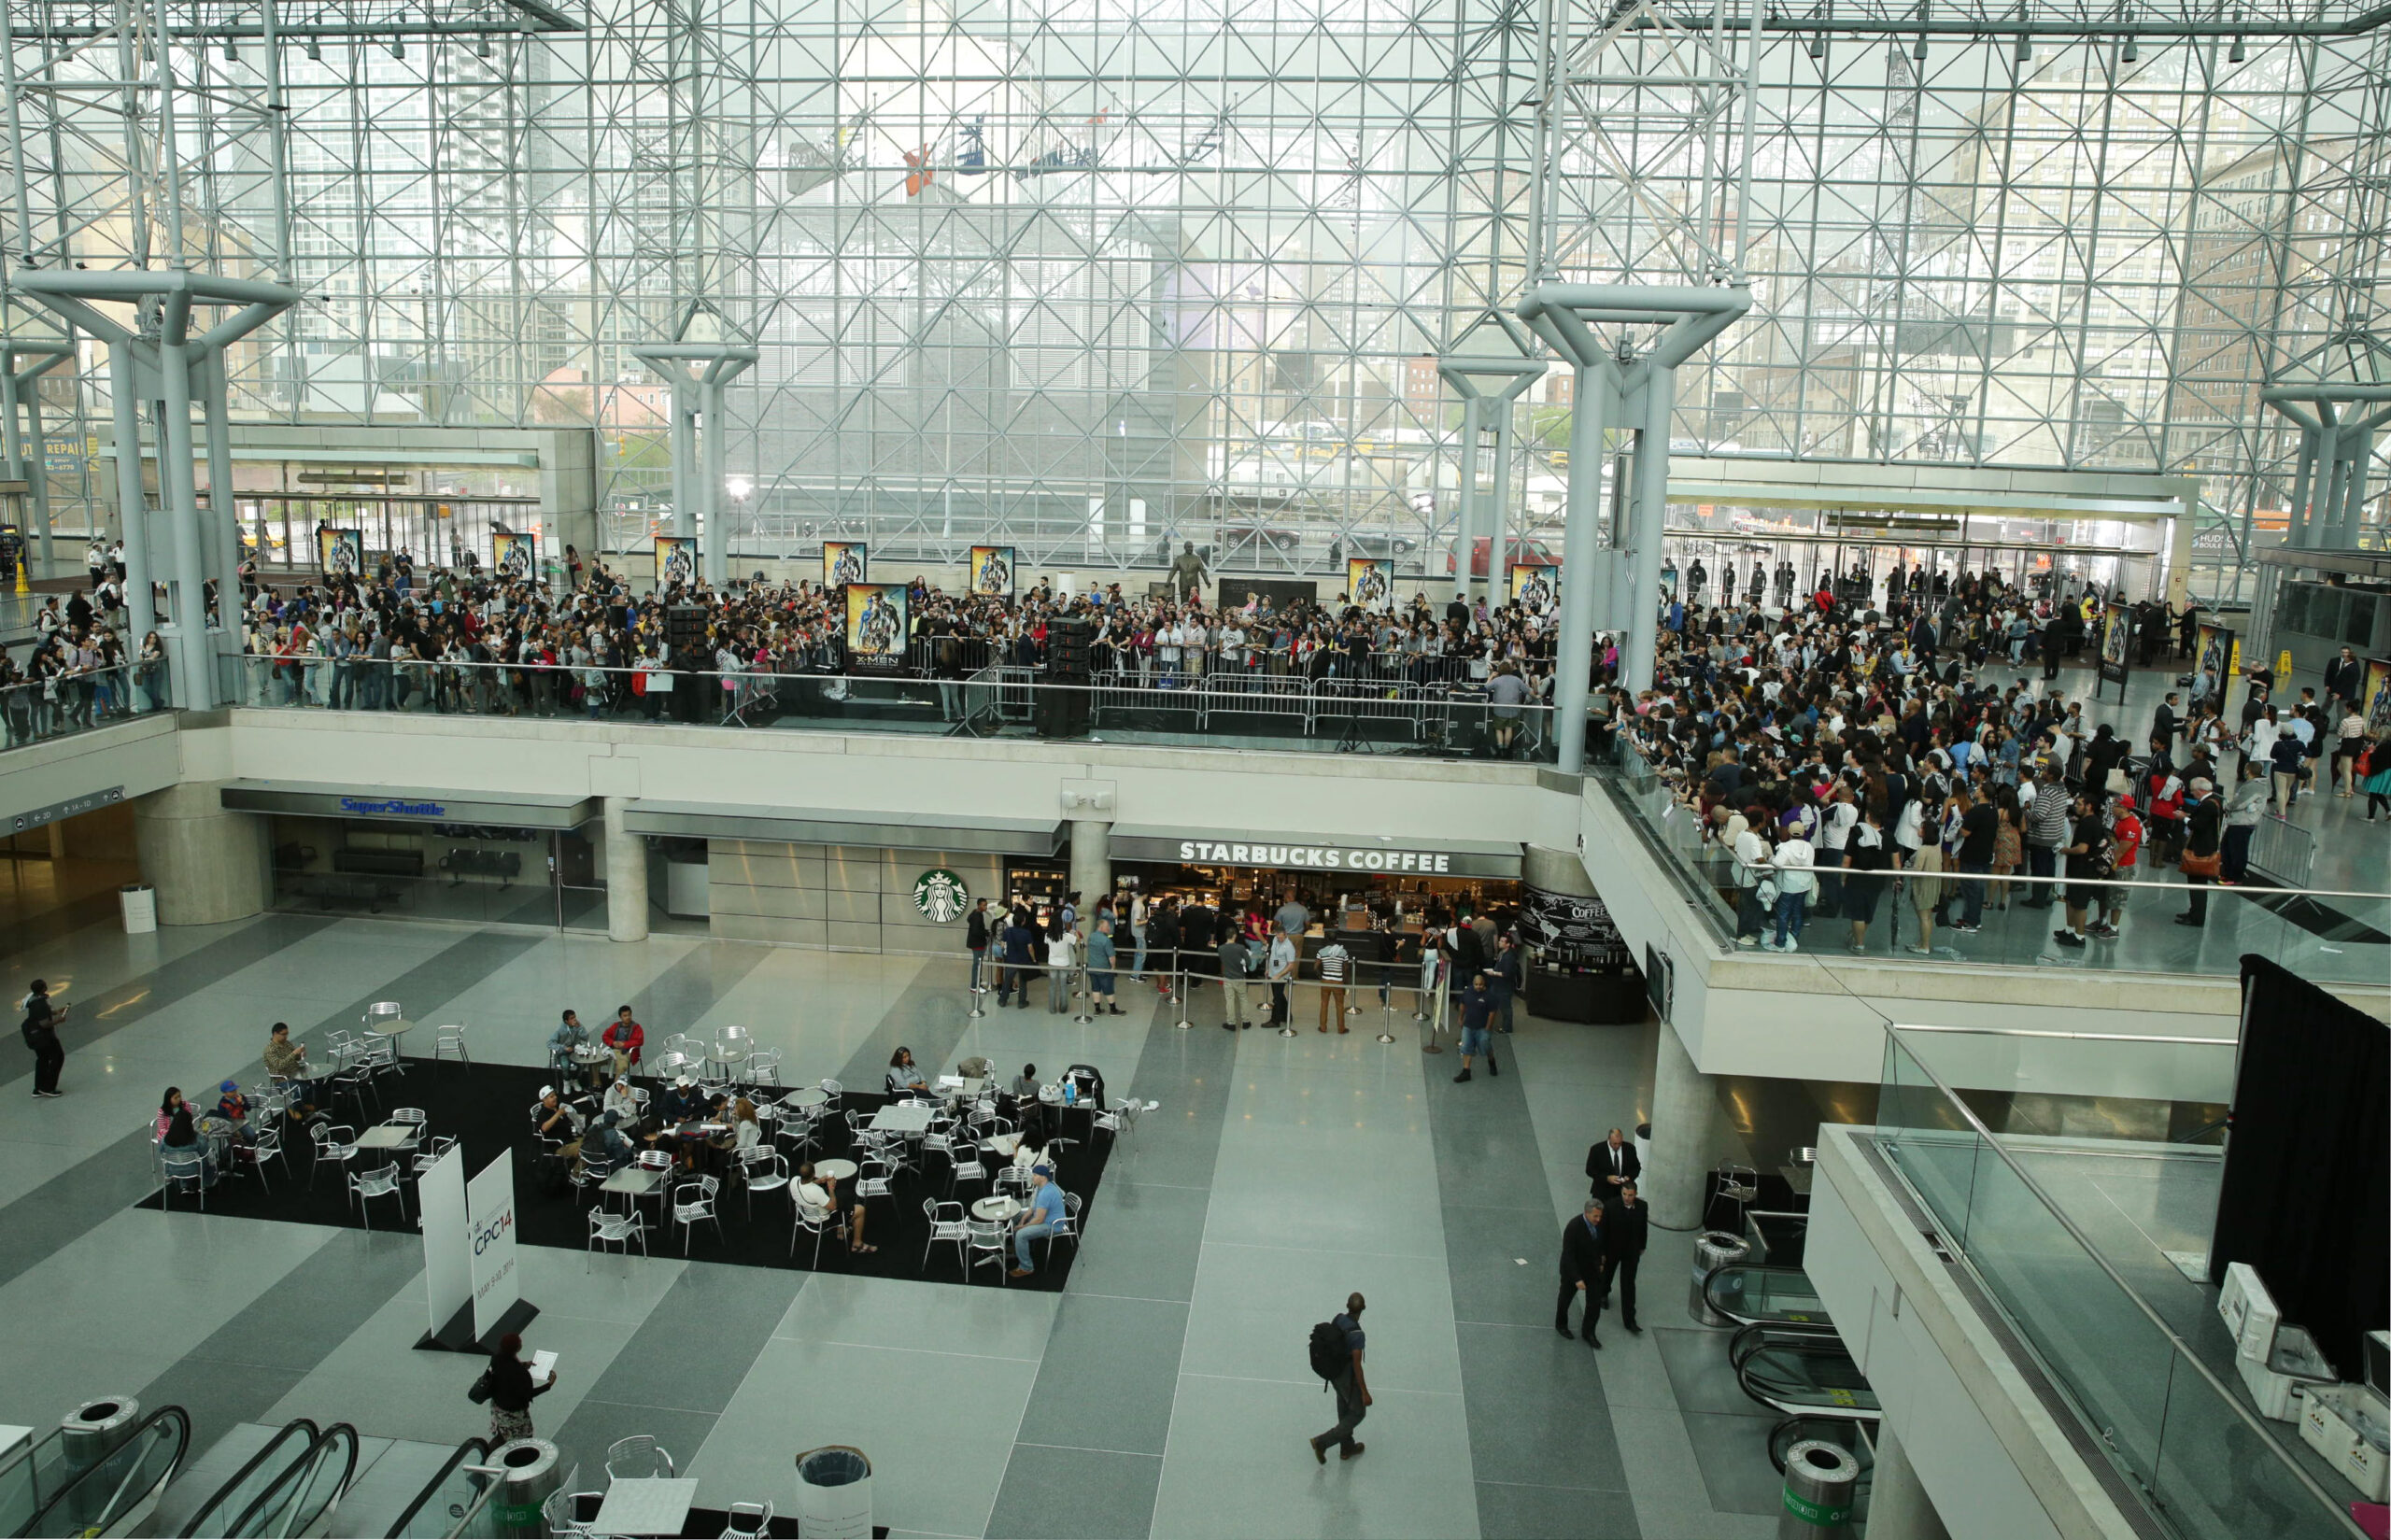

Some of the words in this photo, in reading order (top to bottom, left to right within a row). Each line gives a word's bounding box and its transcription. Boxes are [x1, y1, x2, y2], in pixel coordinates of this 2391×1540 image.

[2200, 534, 2242, 544] HUDON
[856, 656, 898, 664] X-MEN
[43, 812, 51, 820] 2D
[340, 798, 445, 816] SuperShuttle
[1181, 842, 1339, 867] STARBUCKS
[1349, 852, 1449, 872] COFFEE
[475, 1208, 512, 1255] CPC14
[477, 1280, 490, 1300] MAY
[502, 1257, 514, 1276] 2014
